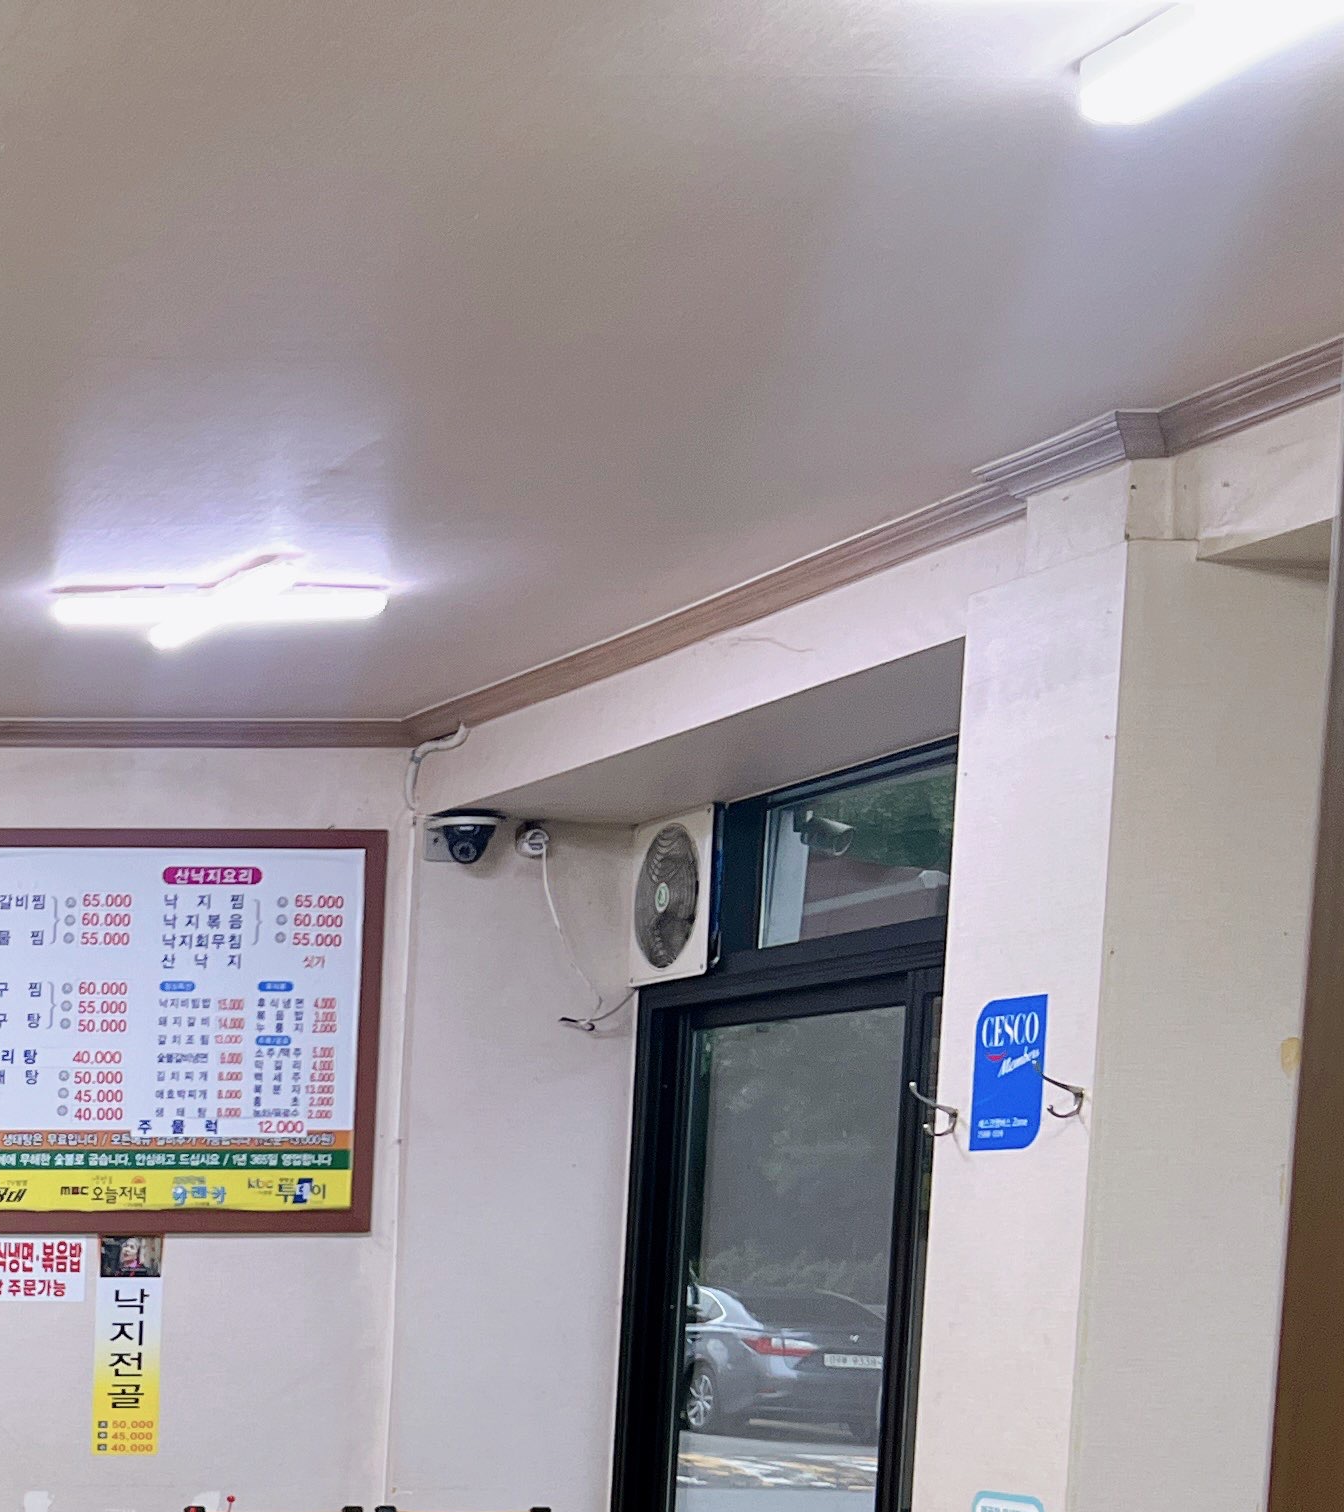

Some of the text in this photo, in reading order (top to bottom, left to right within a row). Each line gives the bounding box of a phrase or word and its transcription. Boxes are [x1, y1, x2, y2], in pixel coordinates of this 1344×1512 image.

[174, 868, 253, 884] 산낙지요리
[82, 893, 132, 908] 65.000
[294, 894, 344, 909] 65.000
[81, 912, 131, 927] 60.000
[293, 913, 344, 928] 60.000
[80, 932, 130, 946] 55.000
[162, 932, 342, 950] 낙지회무침 55.000
[78, 981, 128, 996] 60.000
[77, 1000, 127, 1014] 55.000
[77, 1019, 127, 1033] 50.000
[982, 1011, 1039, 1048] CESCO
[73, 1071, 123, 1085] 50.000
[74, 1089, 124, 1103] 45.000
[74, 1107, 124, 1121] 40.000
[91, 1185, 147, 1204] 오늘저녁
[8, 1279, 66, 1297] 주문가능
[107, 1289, 150, 1409] 낙지전골
